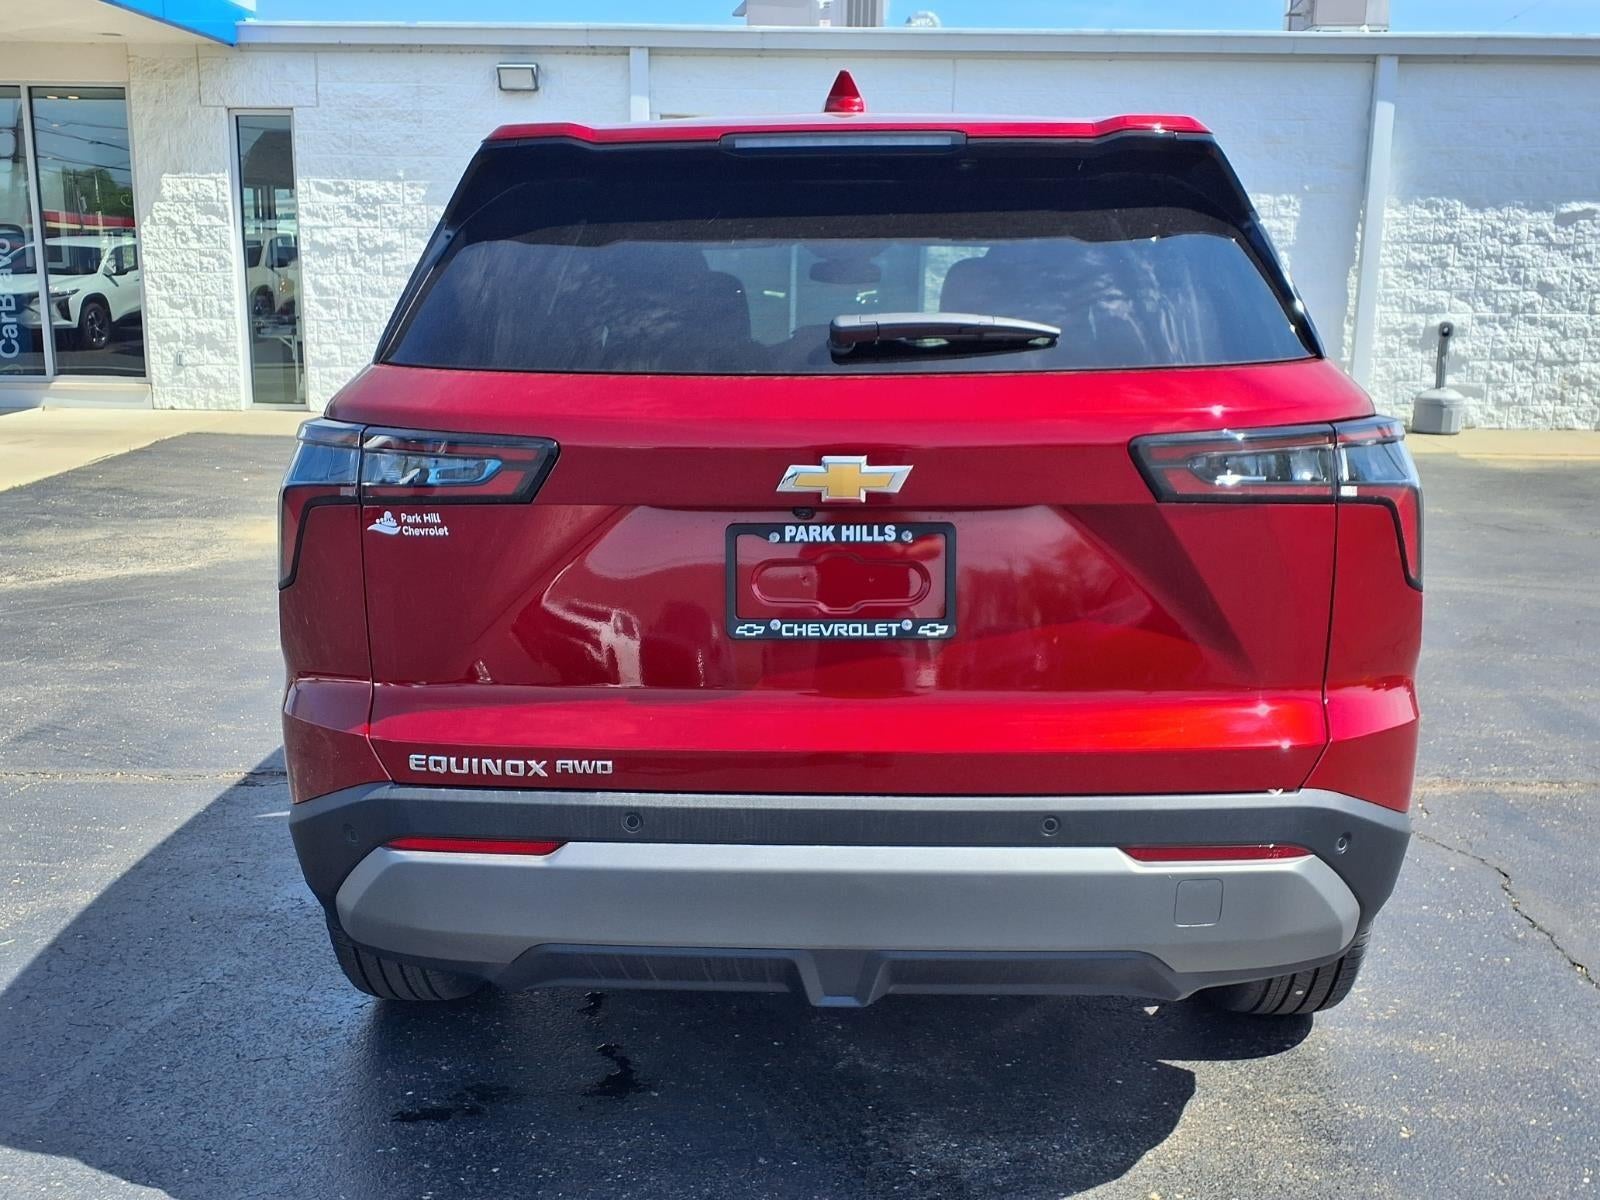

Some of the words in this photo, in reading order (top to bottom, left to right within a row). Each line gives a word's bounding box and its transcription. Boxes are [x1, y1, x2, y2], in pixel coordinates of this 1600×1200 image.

[401, 512, 421, 523] Park
[423, 512, 441, 523] Hill
[402, 525, 449, 536] Chevrolet
[784, 525, 835, 542] PARK
[841, 525, 896, 542] HILLS
[781, 623, 900, 636] CHEVROLET
[409, 754, 548, 777] EQUINOX
[556, 760, 613, 774] AWD
